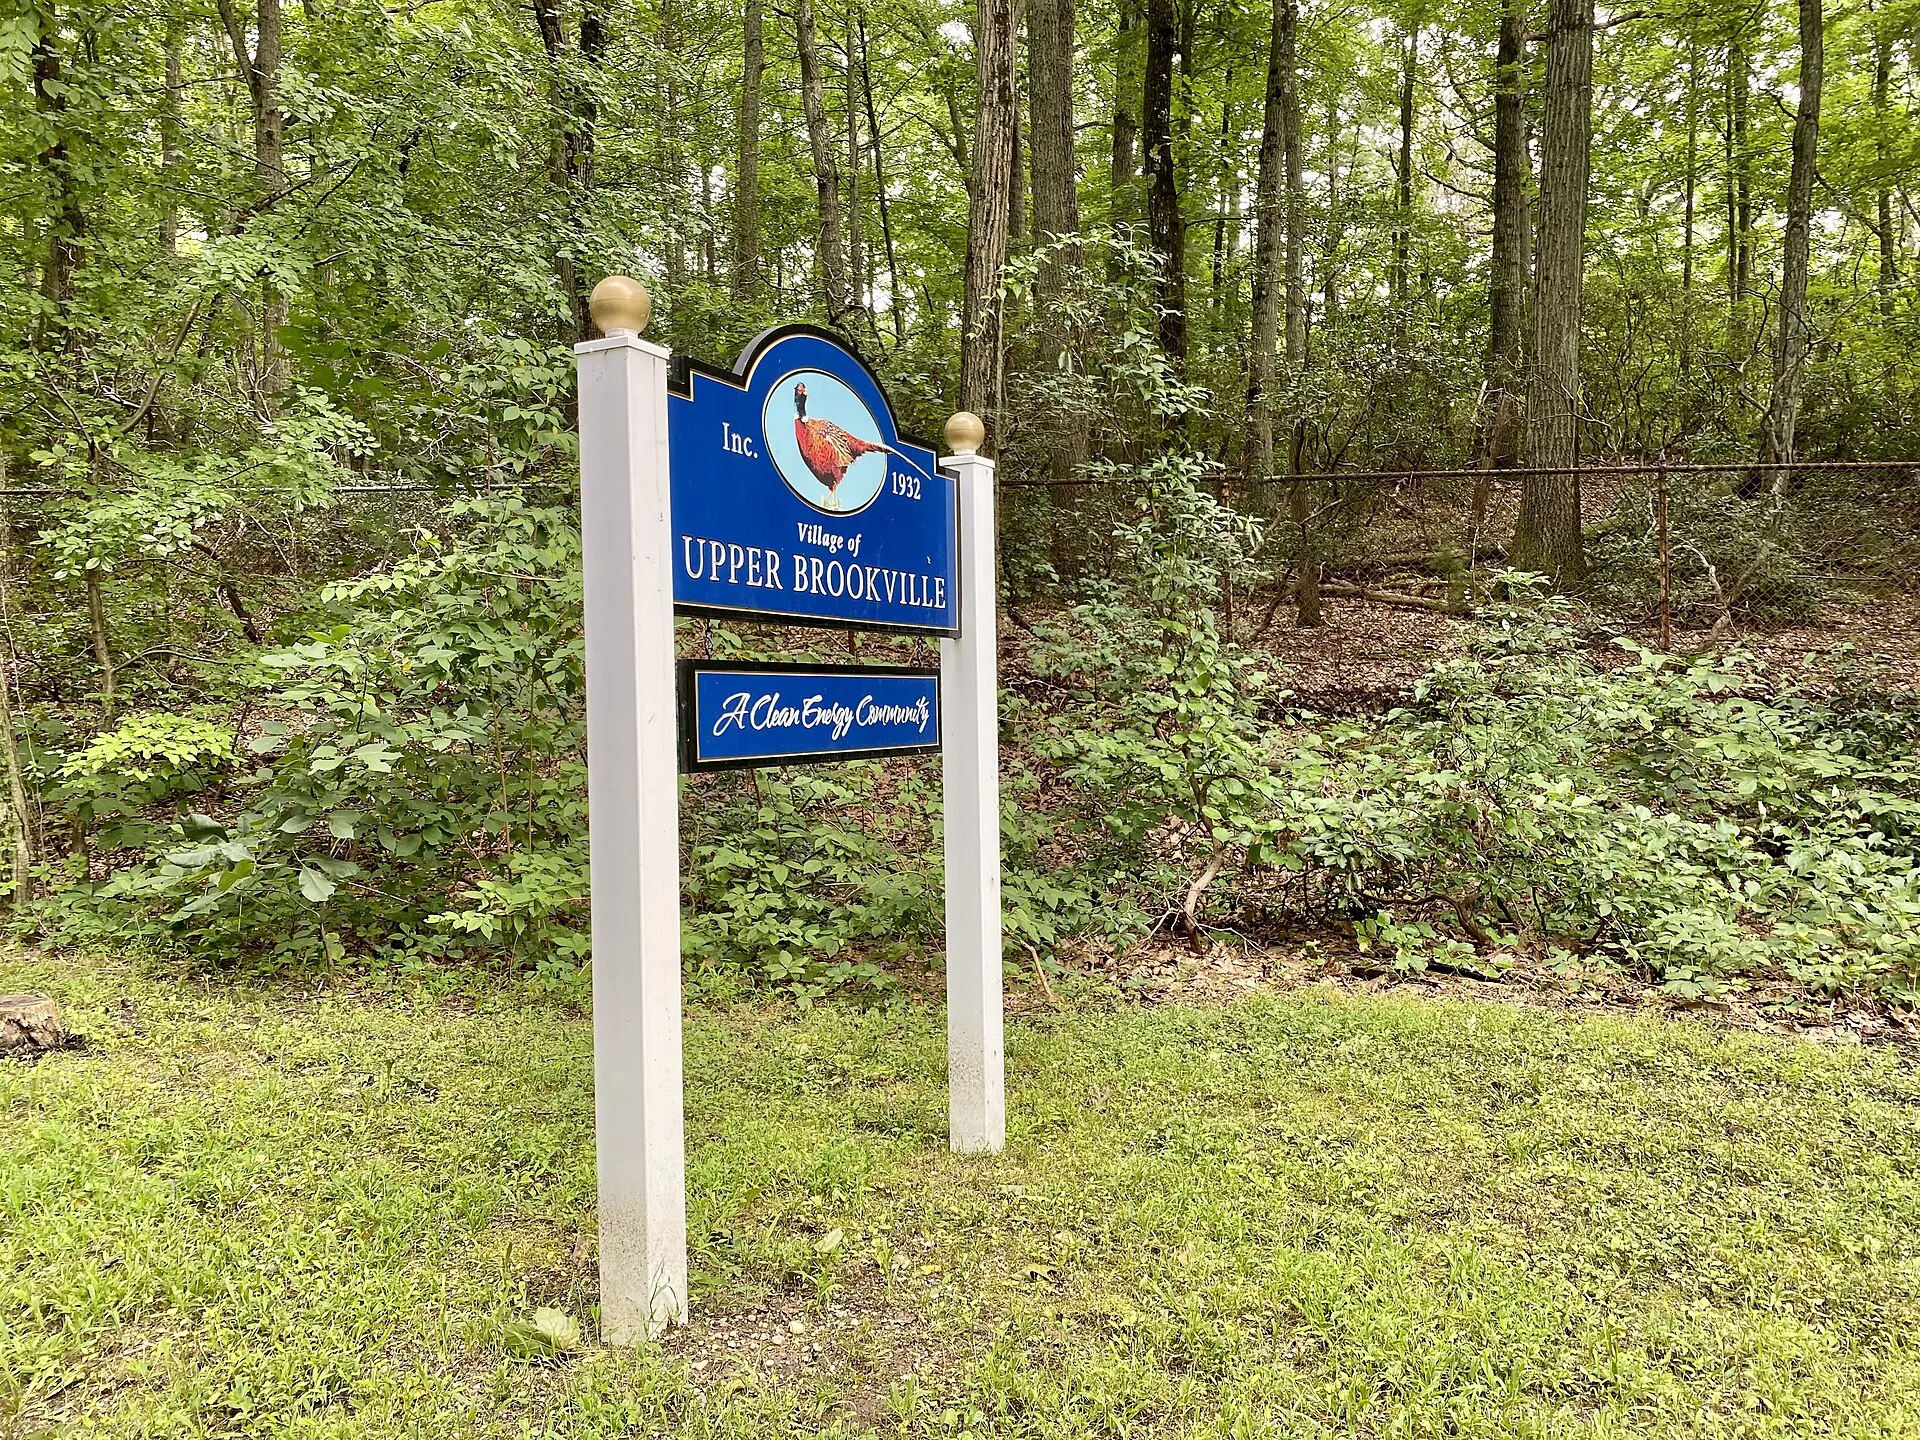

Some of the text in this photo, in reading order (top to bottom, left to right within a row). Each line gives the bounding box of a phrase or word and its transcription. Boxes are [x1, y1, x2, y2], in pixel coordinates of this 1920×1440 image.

[722, 421, 759, 460] Inc.
[891, 471, 922, 501] 1932
[796, 522, 862, 558] Village of
[681, 535, 947, 610] UPPER BROOKVILLE
[712, 692, 930, 741] A Clean Energy Community
